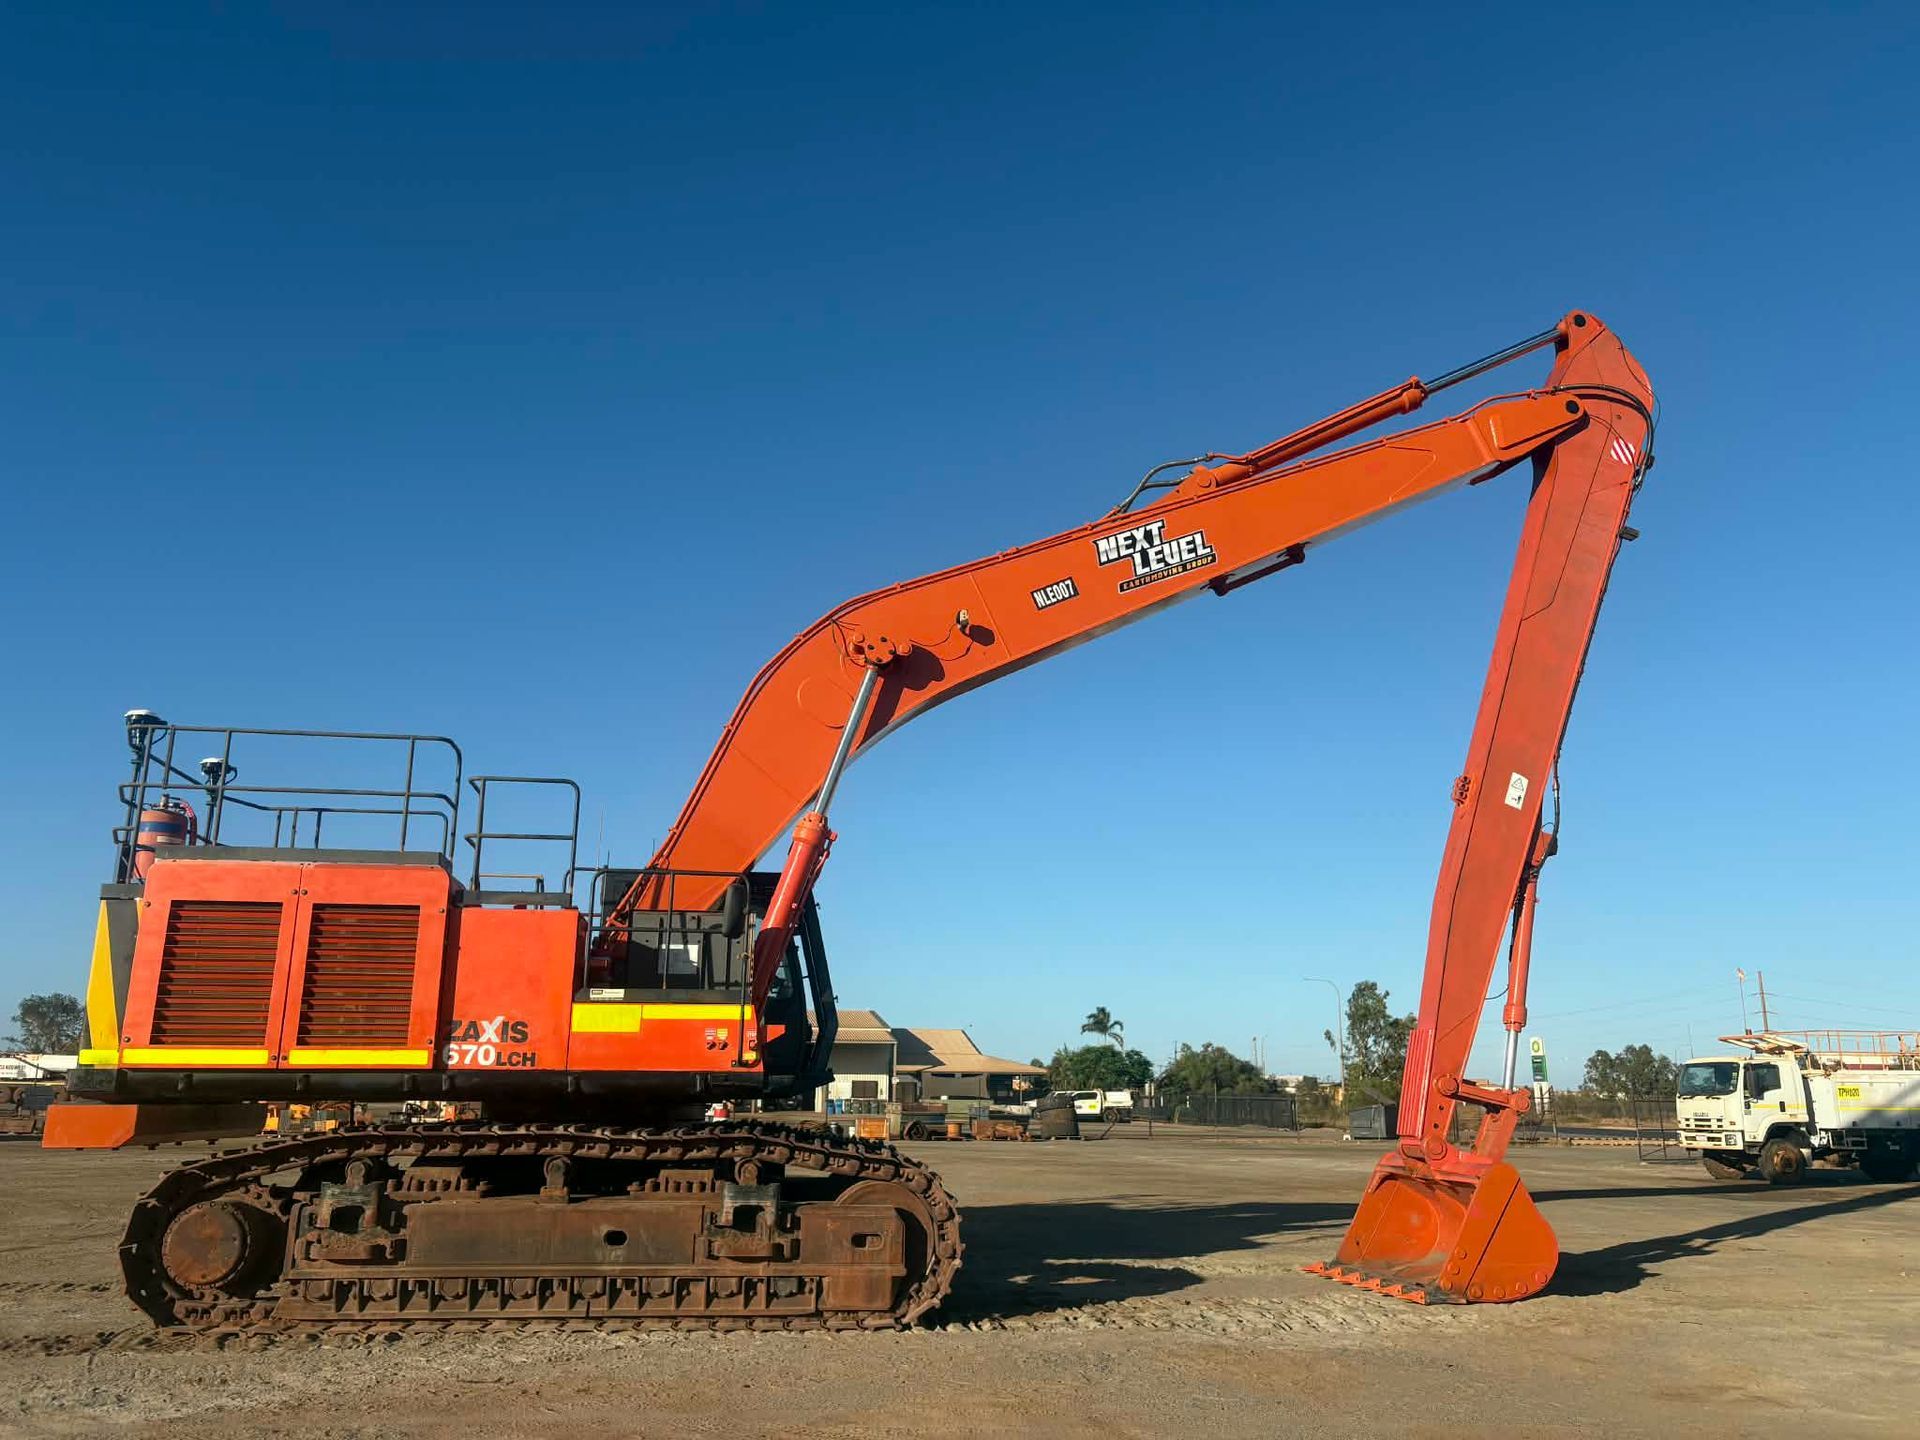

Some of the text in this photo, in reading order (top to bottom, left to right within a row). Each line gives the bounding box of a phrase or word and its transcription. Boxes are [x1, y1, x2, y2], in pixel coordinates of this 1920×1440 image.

[1097, 522, 1164, 563] NEXT
[1132, 533, 1211, 575] LEVEL
[1123, 564, 1183, 590] EARTHMOVING
[1186, 556, 1213, 570] GROUP
[1033, 579, 1075, 608] NLE007
[446, 1016, 528, 1043] ZAXIS
